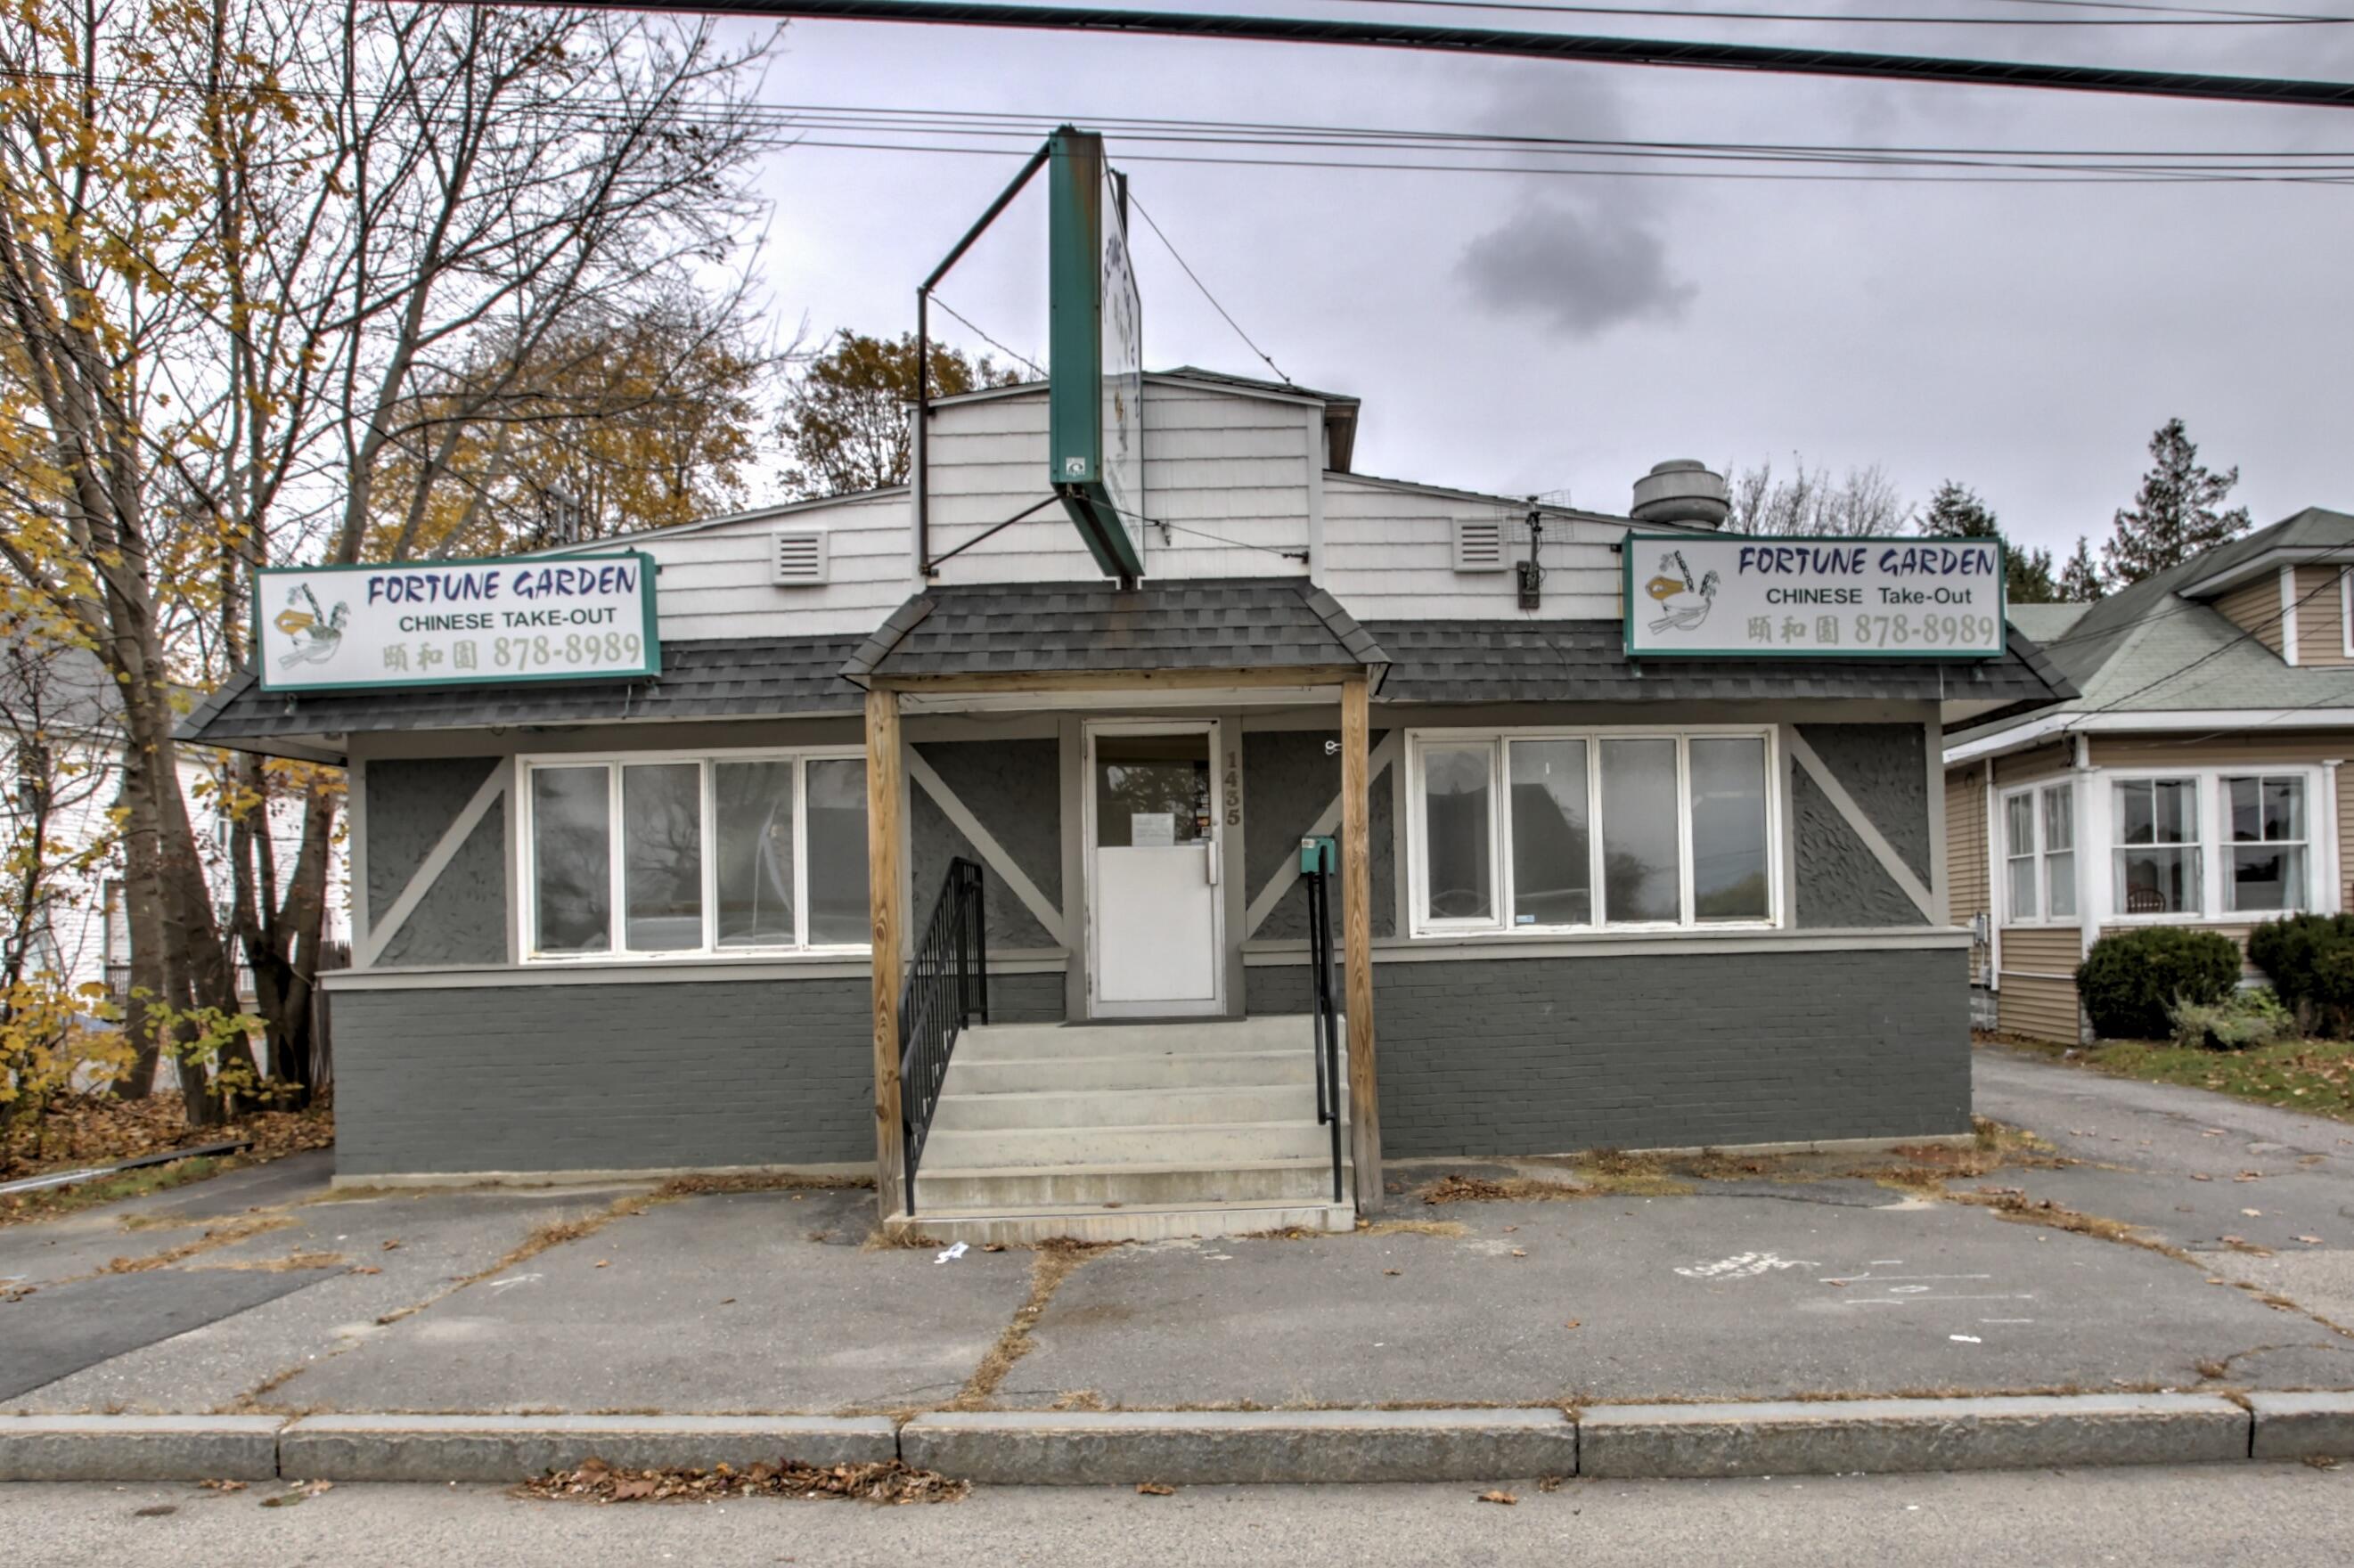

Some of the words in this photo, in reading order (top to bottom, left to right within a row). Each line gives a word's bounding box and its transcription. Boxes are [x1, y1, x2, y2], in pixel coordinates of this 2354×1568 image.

[1738, 546, 1868, 576] FORTUNE
[1878, 546, 1996, 577] GARDEN
[367, 570, 501, 607] FORTUNE
[512, 566, 637, 600] GARDEN
[1766, 588, 1863, 605] CHINESE
[1878, 586, 1973, 605] Take-Out
[399, 613, 495, 633] CHINESE
[502, 607, 617, 628] TAKE-OUT
[1854, 612, 1995, 649] 878-8989
[493, 631, 641, 671] 878-8989
[1224, 751, 1241, 826] 1435
